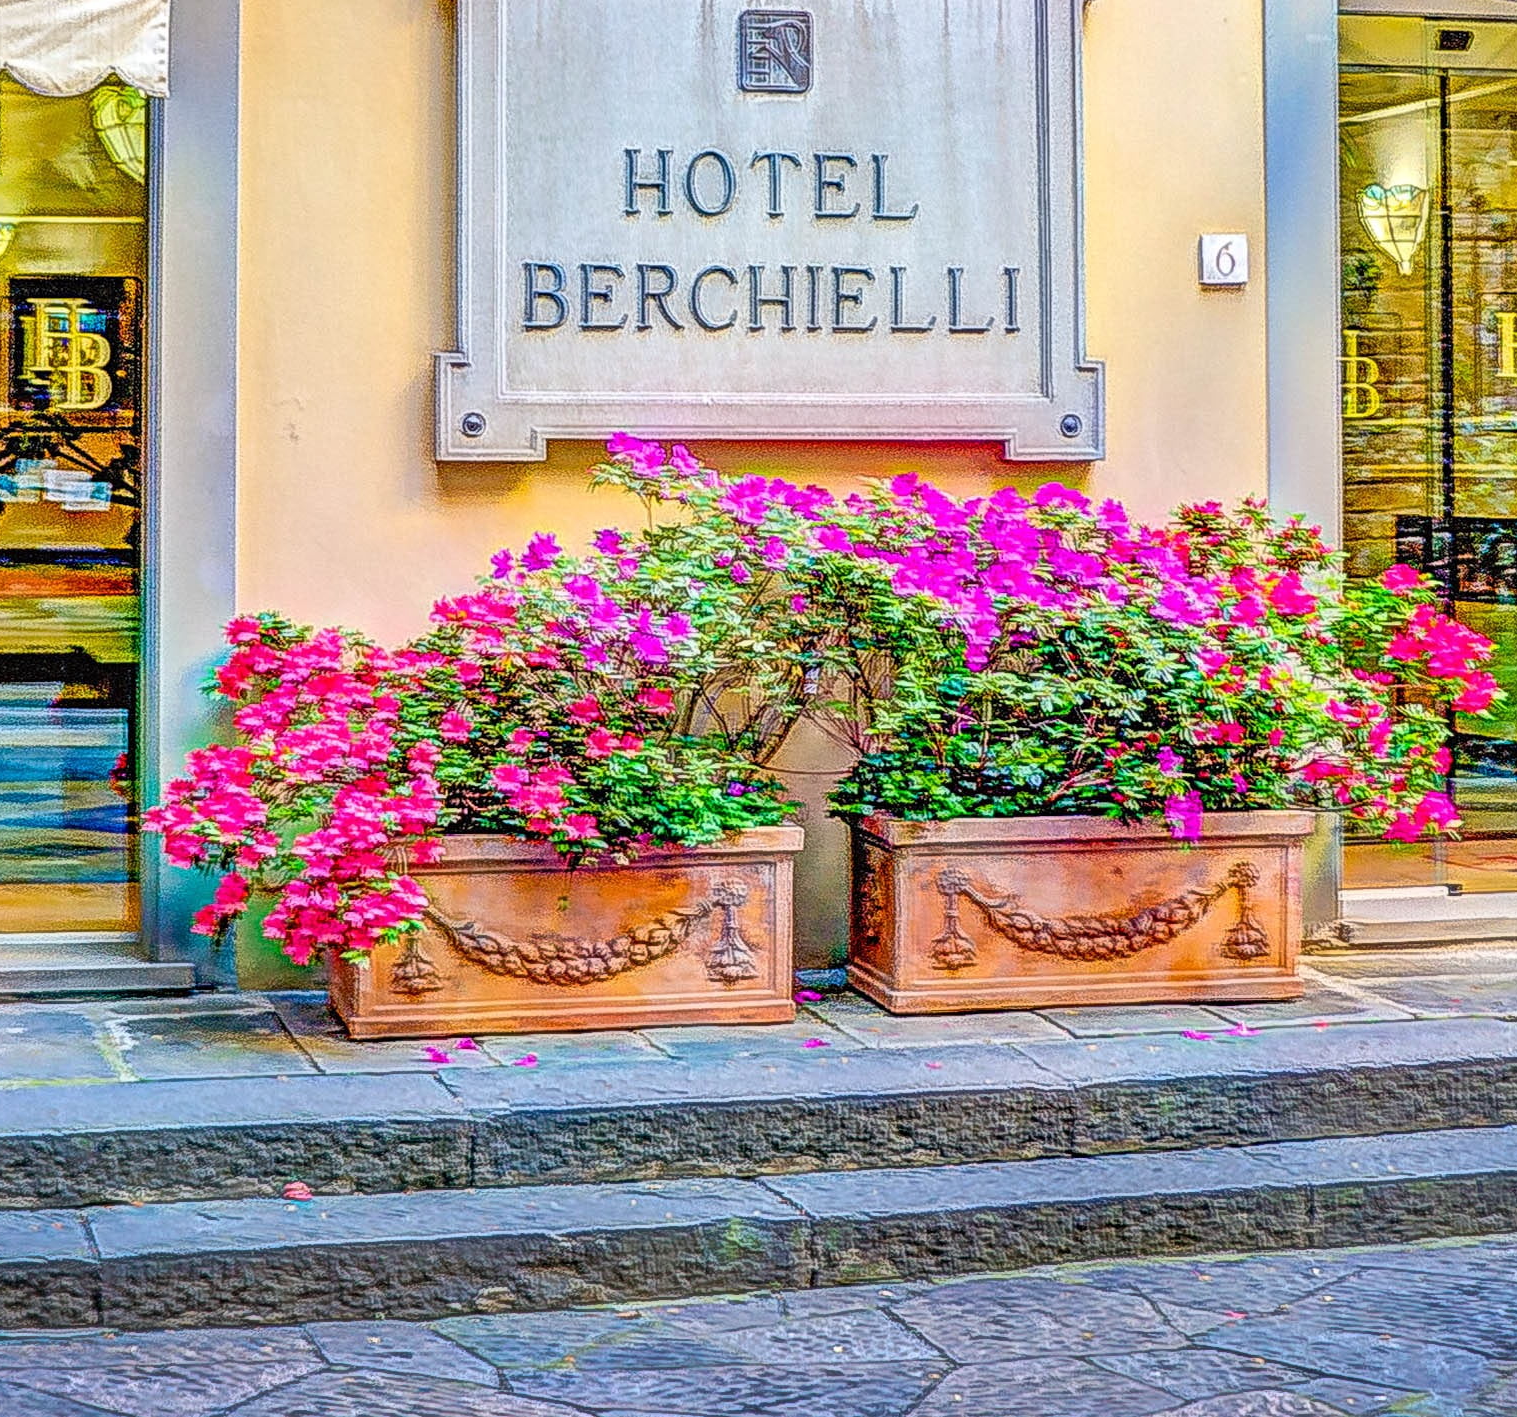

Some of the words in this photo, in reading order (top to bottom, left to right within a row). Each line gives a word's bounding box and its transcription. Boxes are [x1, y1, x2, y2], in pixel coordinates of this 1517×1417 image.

[624, 147, 919, 220] HOTEL
[1216, 241, 1236, 277] 6
[521, 261, 1021, 334] BERCHIELLI
